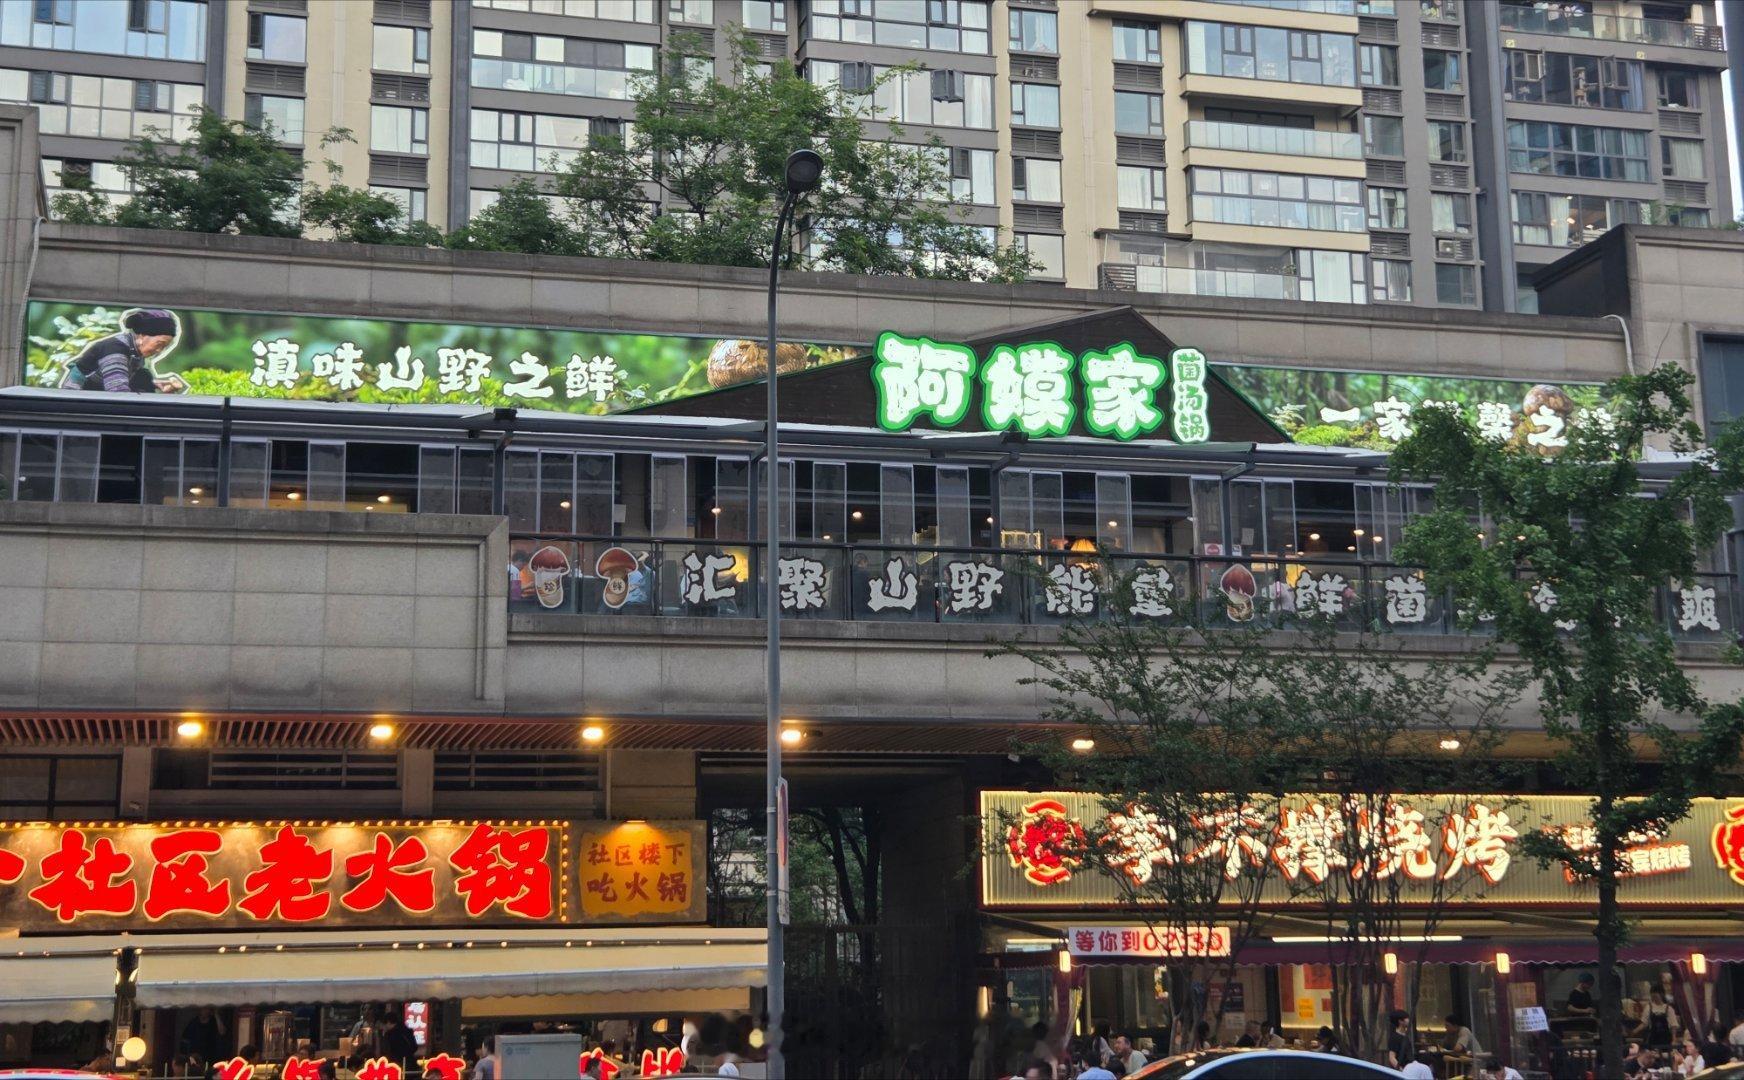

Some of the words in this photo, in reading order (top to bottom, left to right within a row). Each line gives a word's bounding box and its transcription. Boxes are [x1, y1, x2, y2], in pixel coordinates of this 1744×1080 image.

[251, 338, 619, 401] 滇味山野之鲜
[1176, 352, 1205, 439] 菌汤锅
[0, 823, 552, 923] 社区老火锅
[588, 842, 685, 866] 社区楼下
[586, 871, 688, 902] 吃火锅
